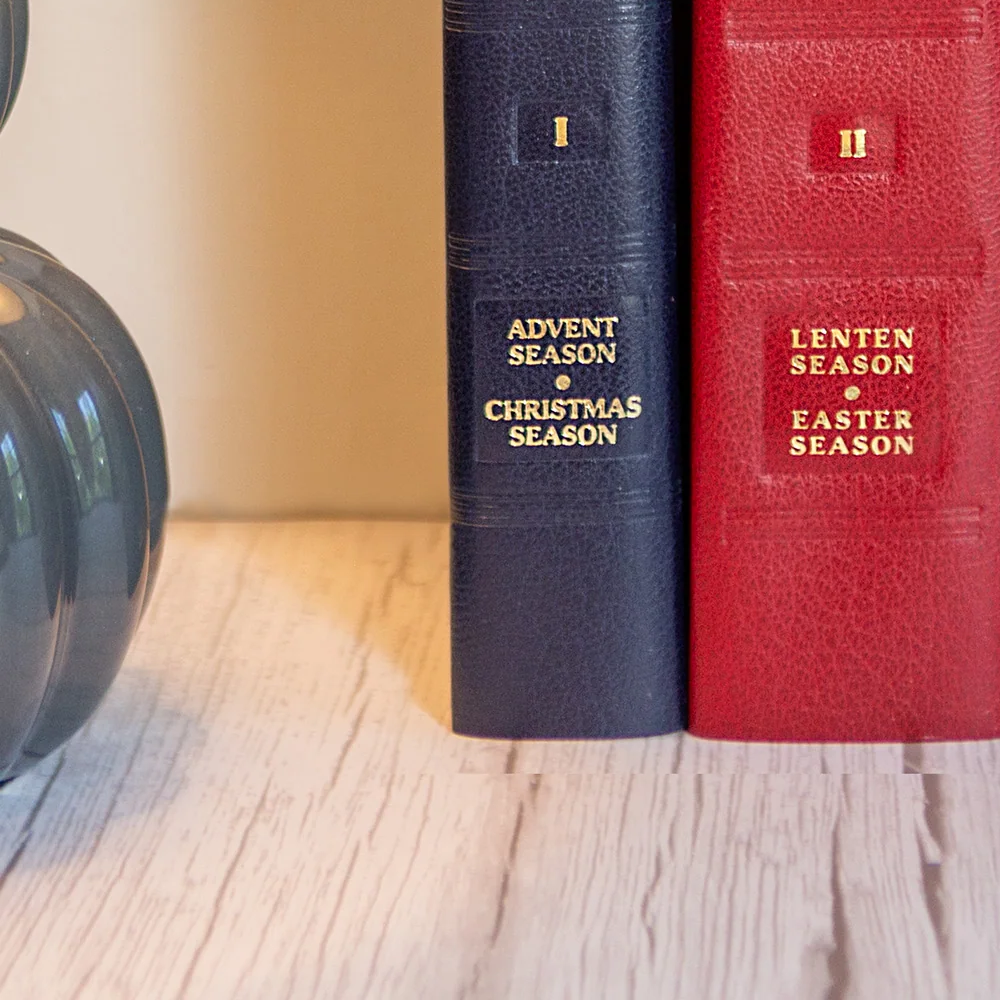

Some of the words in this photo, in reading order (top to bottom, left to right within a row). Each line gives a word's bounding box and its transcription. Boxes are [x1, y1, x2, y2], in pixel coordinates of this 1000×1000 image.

[553, 116, 569, 148] I
[838, 128, 868, 160] II
[507, 316, 619, 341] ADVENT
[790, 326, 916, 350] LENTEN
[508, 342, 618, 366] SEASON
[789, 354, 915, 376] SEASON
[484, 395, 642, 421] CHRISTMAS
[791, 408, 913, 431] EASTER
[508, 423, 618, 447] SEASON
[788, 435, 915, 457] SEASON
